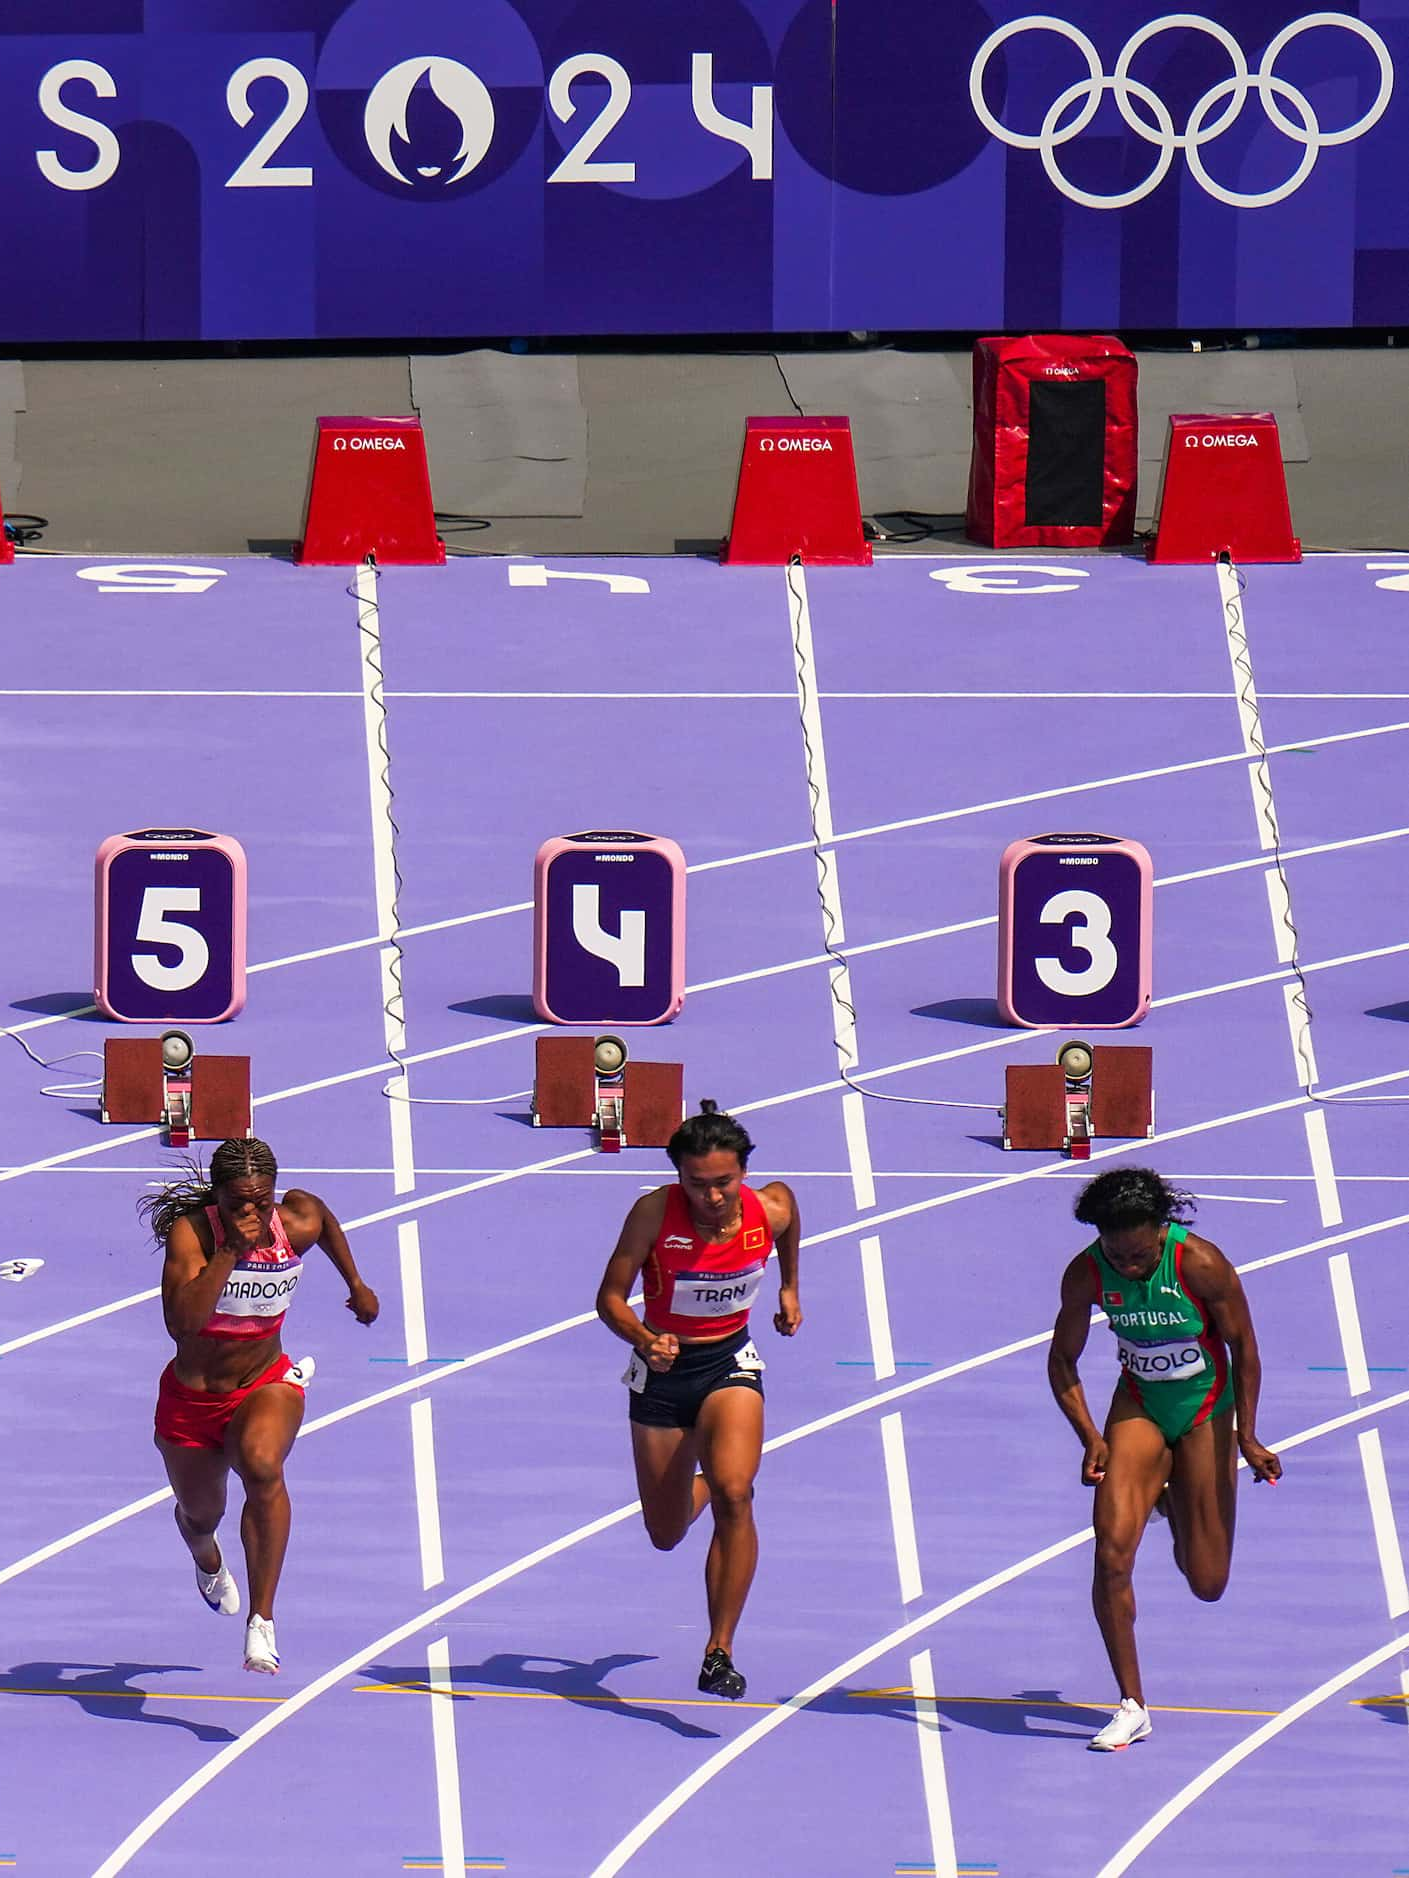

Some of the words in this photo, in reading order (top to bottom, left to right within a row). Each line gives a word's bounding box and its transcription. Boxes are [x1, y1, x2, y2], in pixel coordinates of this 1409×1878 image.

[225, 54, 773, 187] 2024
[350, 437, 406, 450] OMEGA
[778, 438, 833, 452] OMEGA
[1202, 434, 1259, 448] OMEGA
[77, 565, 227, 593] 5
[508, 565, 650, 594] 4
[930, 566, 1090, 594] 3
[157, 853, 189, 861] MONDO
[601, 854, 635, 862] MONDO
[1065, 857, 1099, 865] MONDO
[131, 887, 209, 991] 5
[573, 884, 645, 987] 4
[1034, 889, 1118, 996] 3
[223, 1275, 298, 1299] MADOGO
[693, 1283, 747, 1303] TRAN
[1112, 1310, 1189, 1327] PORTUGAL
[1118, 1346, 1201, 1373] BAZOLO
